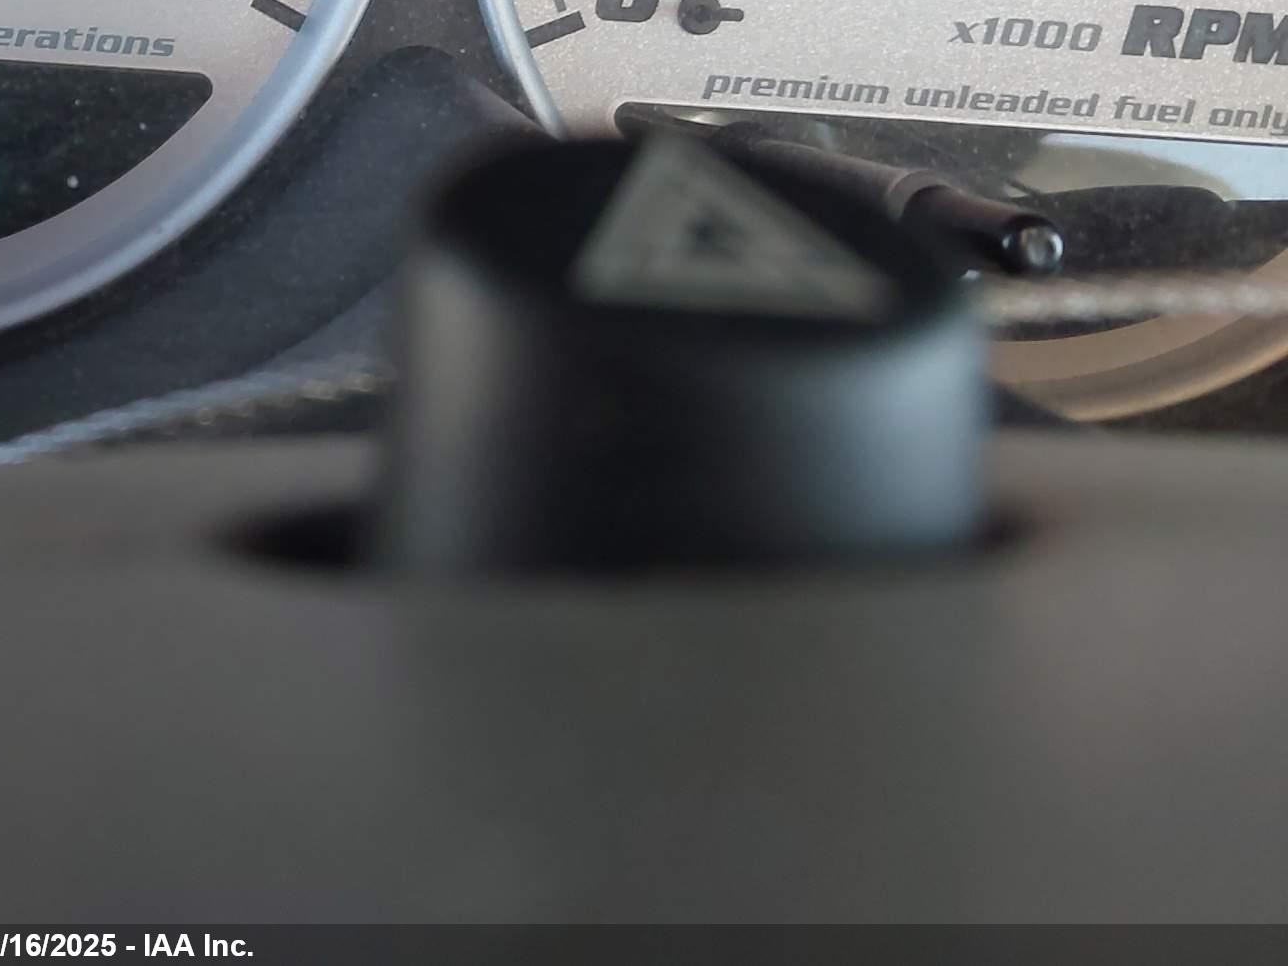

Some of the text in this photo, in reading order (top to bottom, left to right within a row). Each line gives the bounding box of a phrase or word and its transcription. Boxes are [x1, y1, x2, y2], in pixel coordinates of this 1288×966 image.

[948, 5, 1288, 65] x1000 RPM
[702, 73, 1288, 136] premium unleaded fuel only
